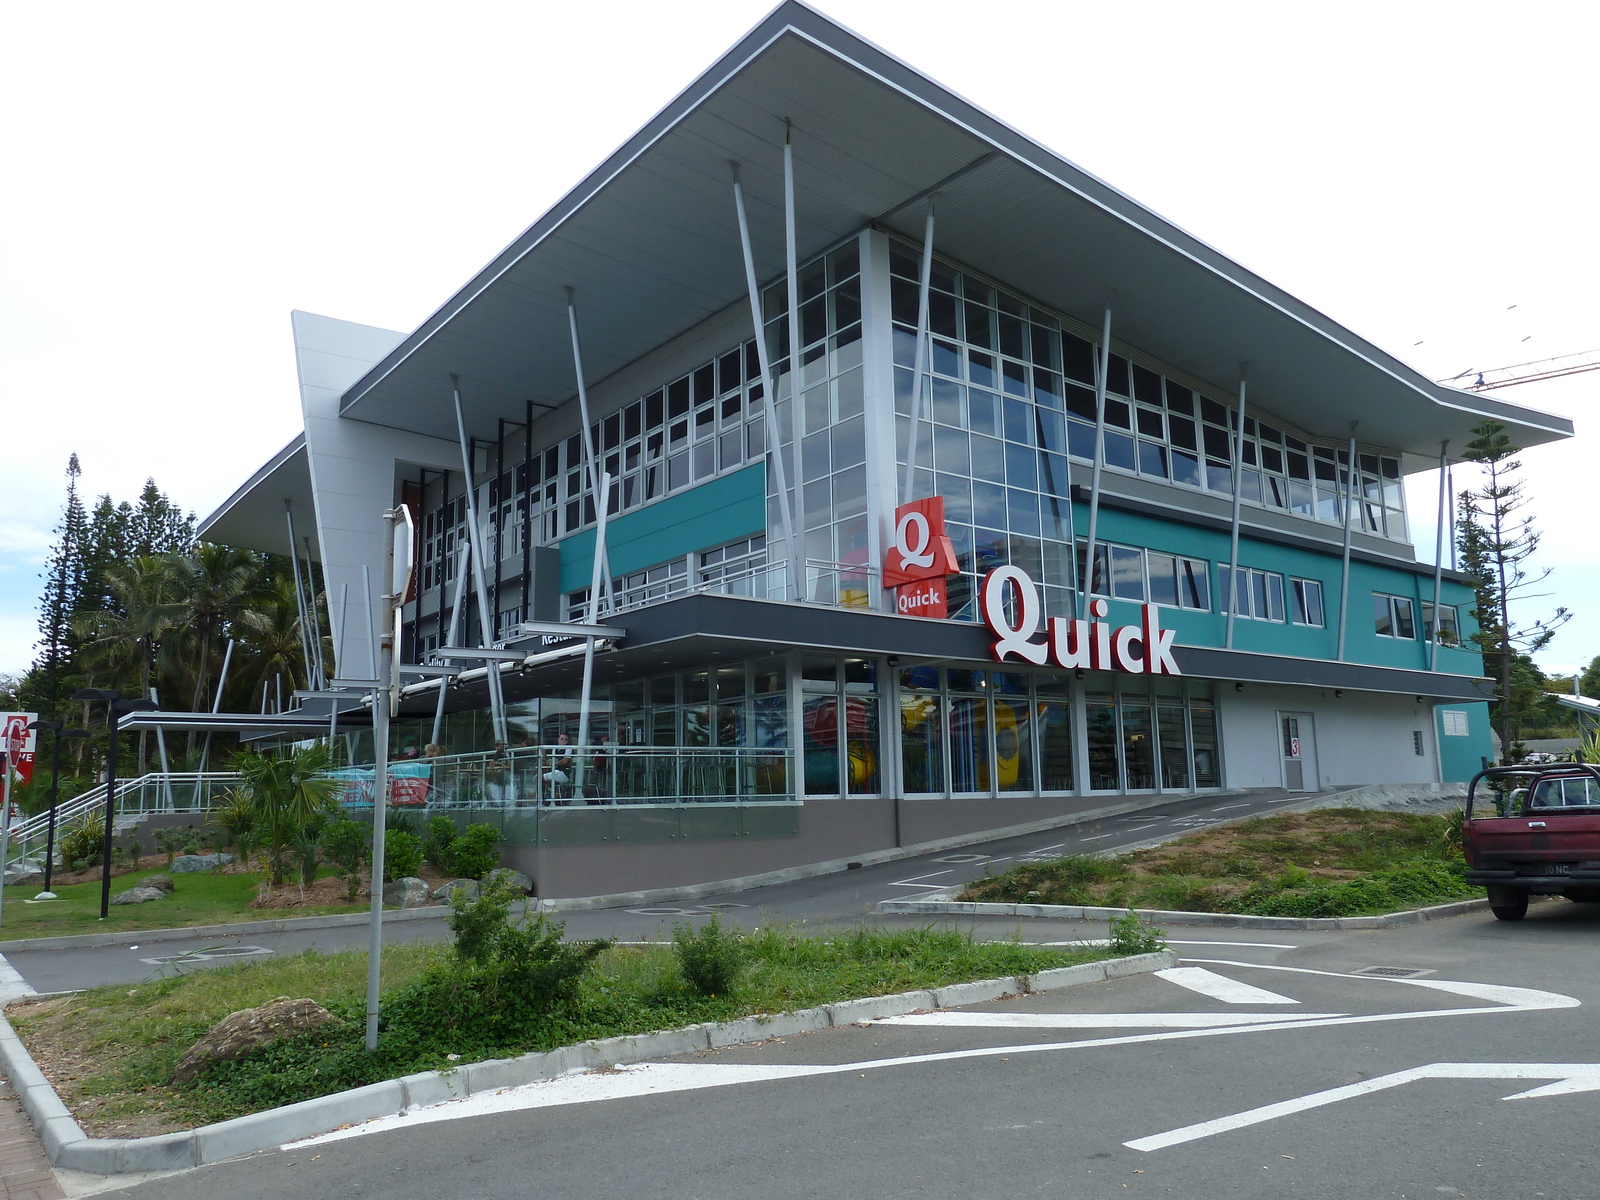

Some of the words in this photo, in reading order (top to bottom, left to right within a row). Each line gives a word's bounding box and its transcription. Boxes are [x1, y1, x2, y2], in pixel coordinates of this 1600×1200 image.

[896, 512, 934, 571] Q
[898, 586, 941, 613] Quick
[981, 565, 1182, 675] Quick
[11, 738, 21, 752] STOP
[1292, 738, 1298, 755] 3
